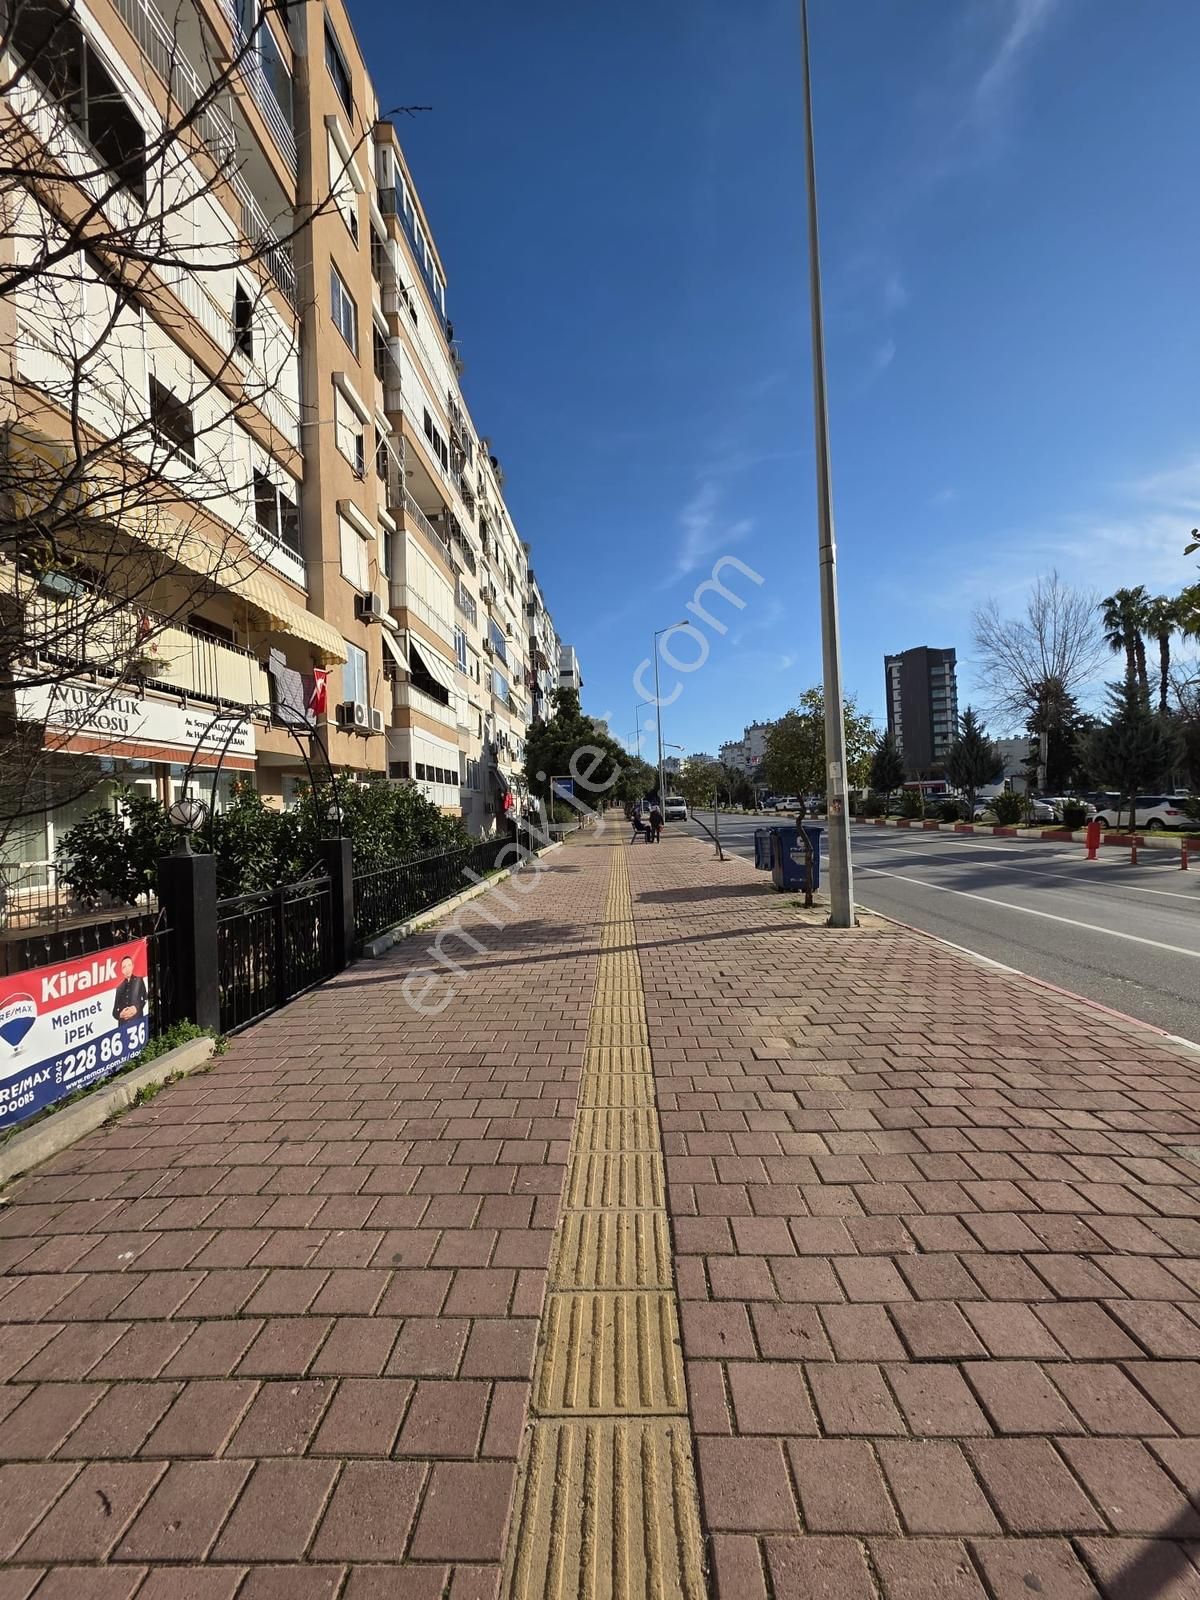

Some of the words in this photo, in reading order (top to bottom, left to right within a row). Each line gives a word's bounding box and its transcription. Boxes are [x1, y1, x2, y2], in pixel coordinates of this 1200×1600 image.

[41, 958, 118, 1003] Kiralık
[52, 1000, 103, 1030] Mehmet
[65, 1022, 95, 1045] İPEK
[63, 1044, 97, 1082] 228
[100, 1032, 124, 1062] 86
[127, 1022, 146, 1049] 36
[0, 1066, 53, 1103] RE/MAX
[55, 1059, 63, 1084] 0242
[0, 1090, 35, 1117] DOORS
